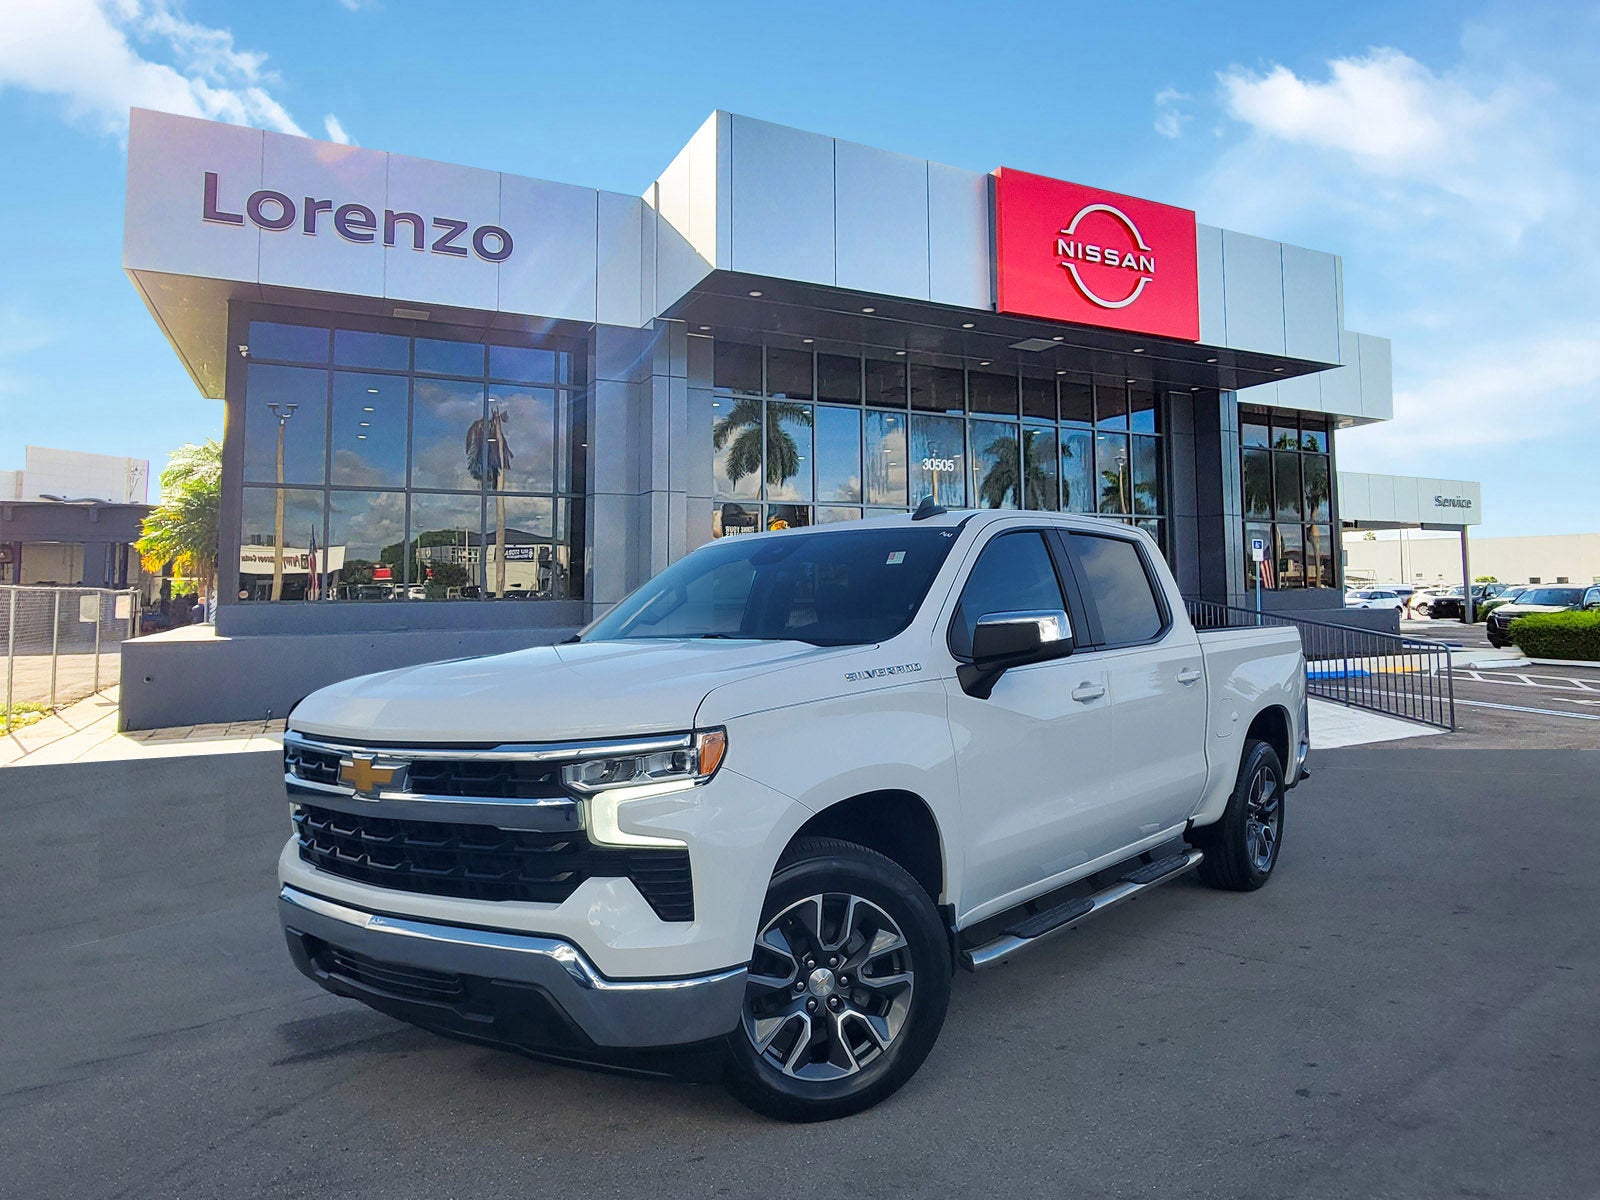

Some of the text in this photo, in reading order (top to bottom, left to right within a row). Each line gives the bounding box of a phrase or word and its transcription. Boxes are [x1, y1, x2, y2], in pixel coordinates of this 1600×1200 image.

[202, 171, 514, 262] Lorenzo
[1057, 238, 1155, 273] NISSAN
[922, 458, 955, 471] 30505
[1434, 495, 1472, 508] Service
[843, 662, 922, 682] SILVERADO
